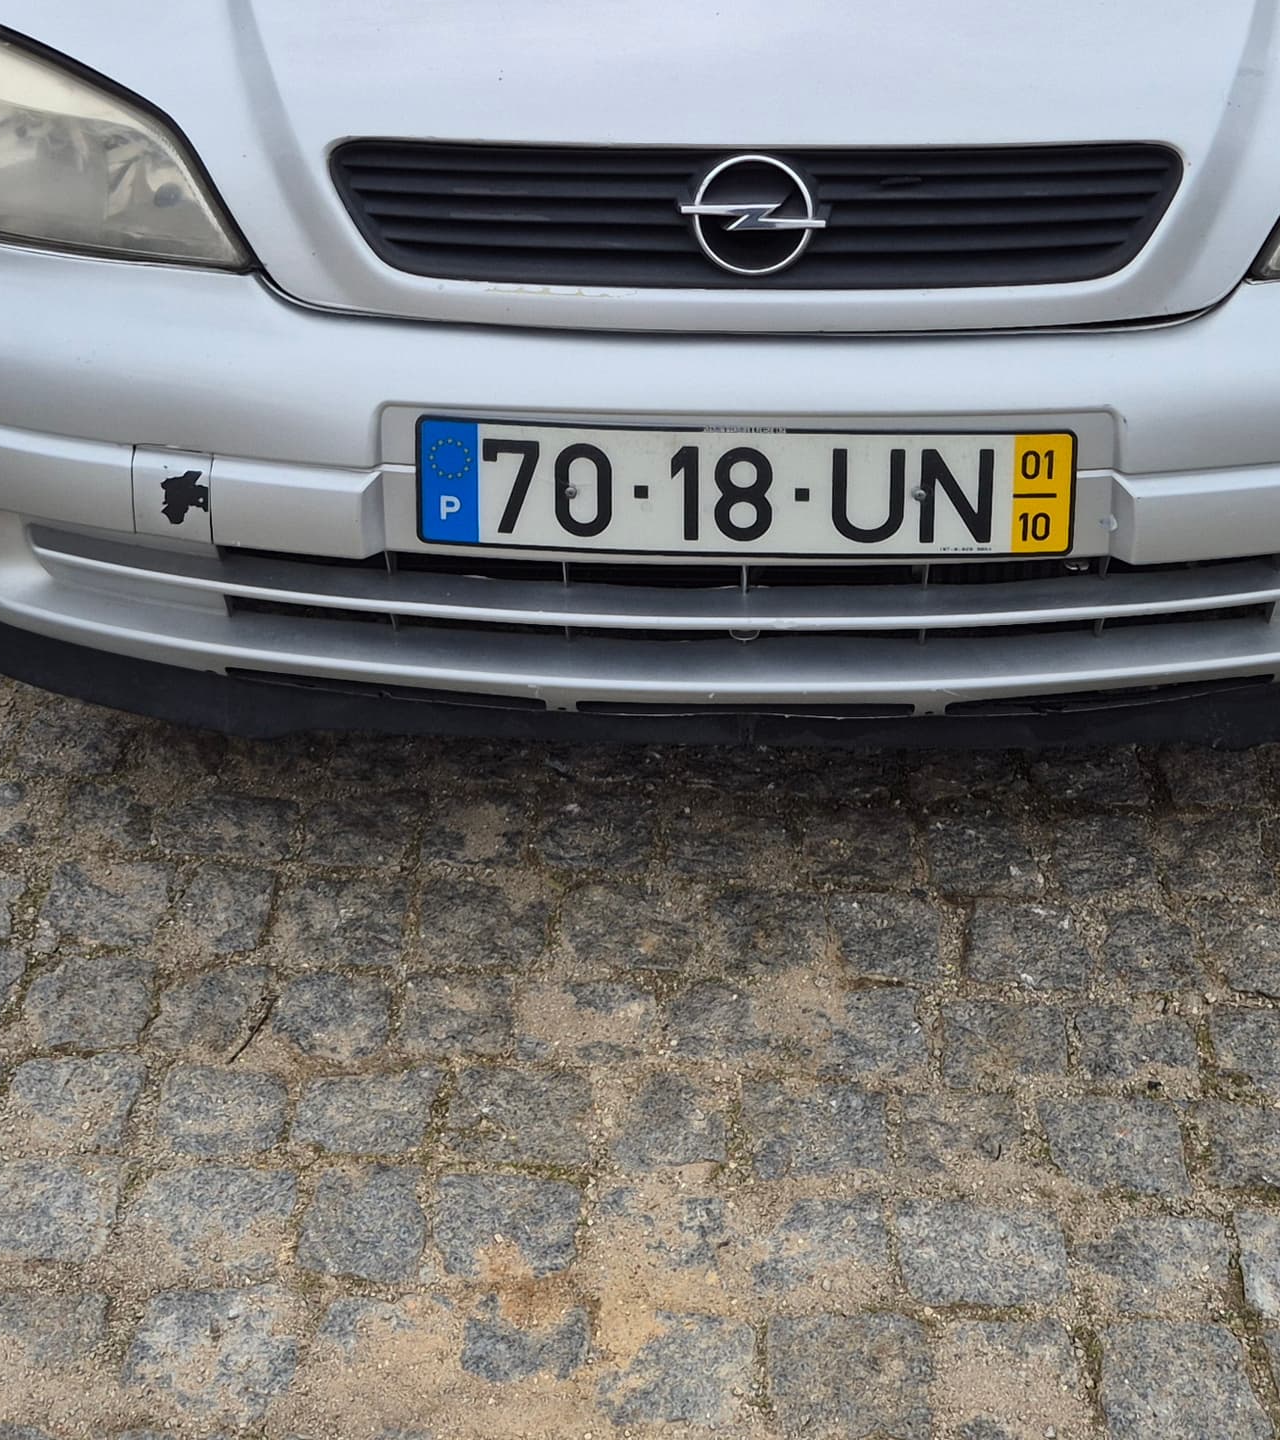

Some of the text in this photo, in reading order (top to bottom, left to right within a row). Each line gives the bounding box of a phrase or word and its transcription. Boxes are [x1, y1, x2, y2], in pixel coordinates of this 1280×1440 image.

[1021, 450, 1055, 480] 01
[439, 495, 461, 521] P
[1019, 513, 1051, 542] 10
